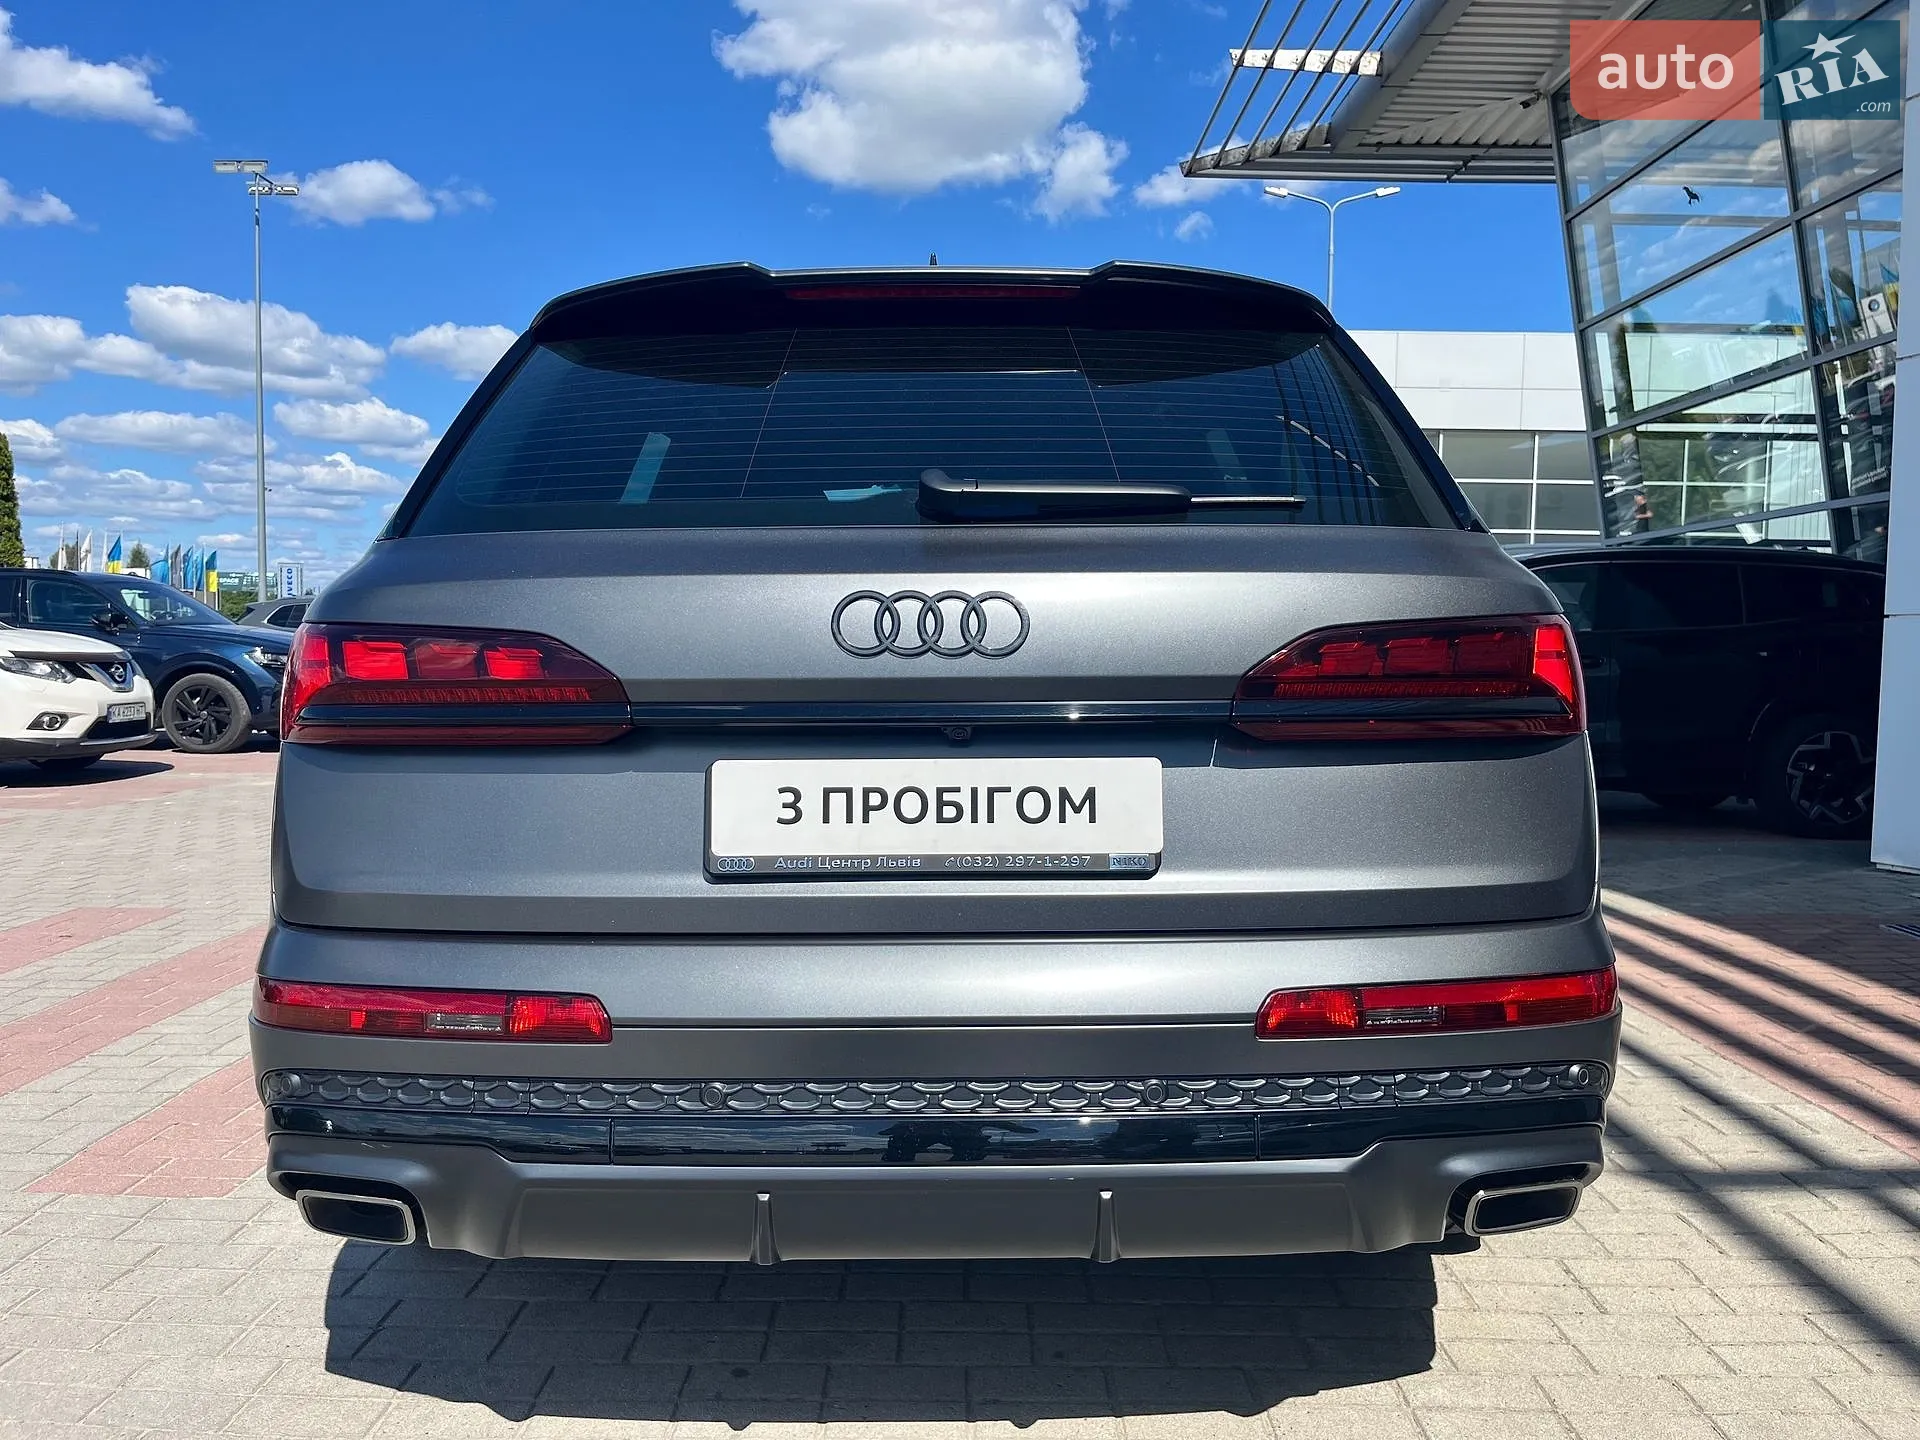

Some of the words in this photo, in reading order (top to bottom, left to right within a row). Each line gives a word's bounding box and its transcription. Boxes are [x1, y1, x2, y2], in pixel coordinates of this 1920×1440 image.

[776, 786, 803, 825] З
[822, 786, 1097, 825] ПРОБІГОМ
[774, 856, 813, 869] Audi
[817, 856, 872, 870] Центр
[875, 856, 921, 868] Львів
[956, 855, 1000, 868] (032)
[1004, 855, 1092, 868] 297-1-297
[1111, 856, 1148, 867] NIKO
